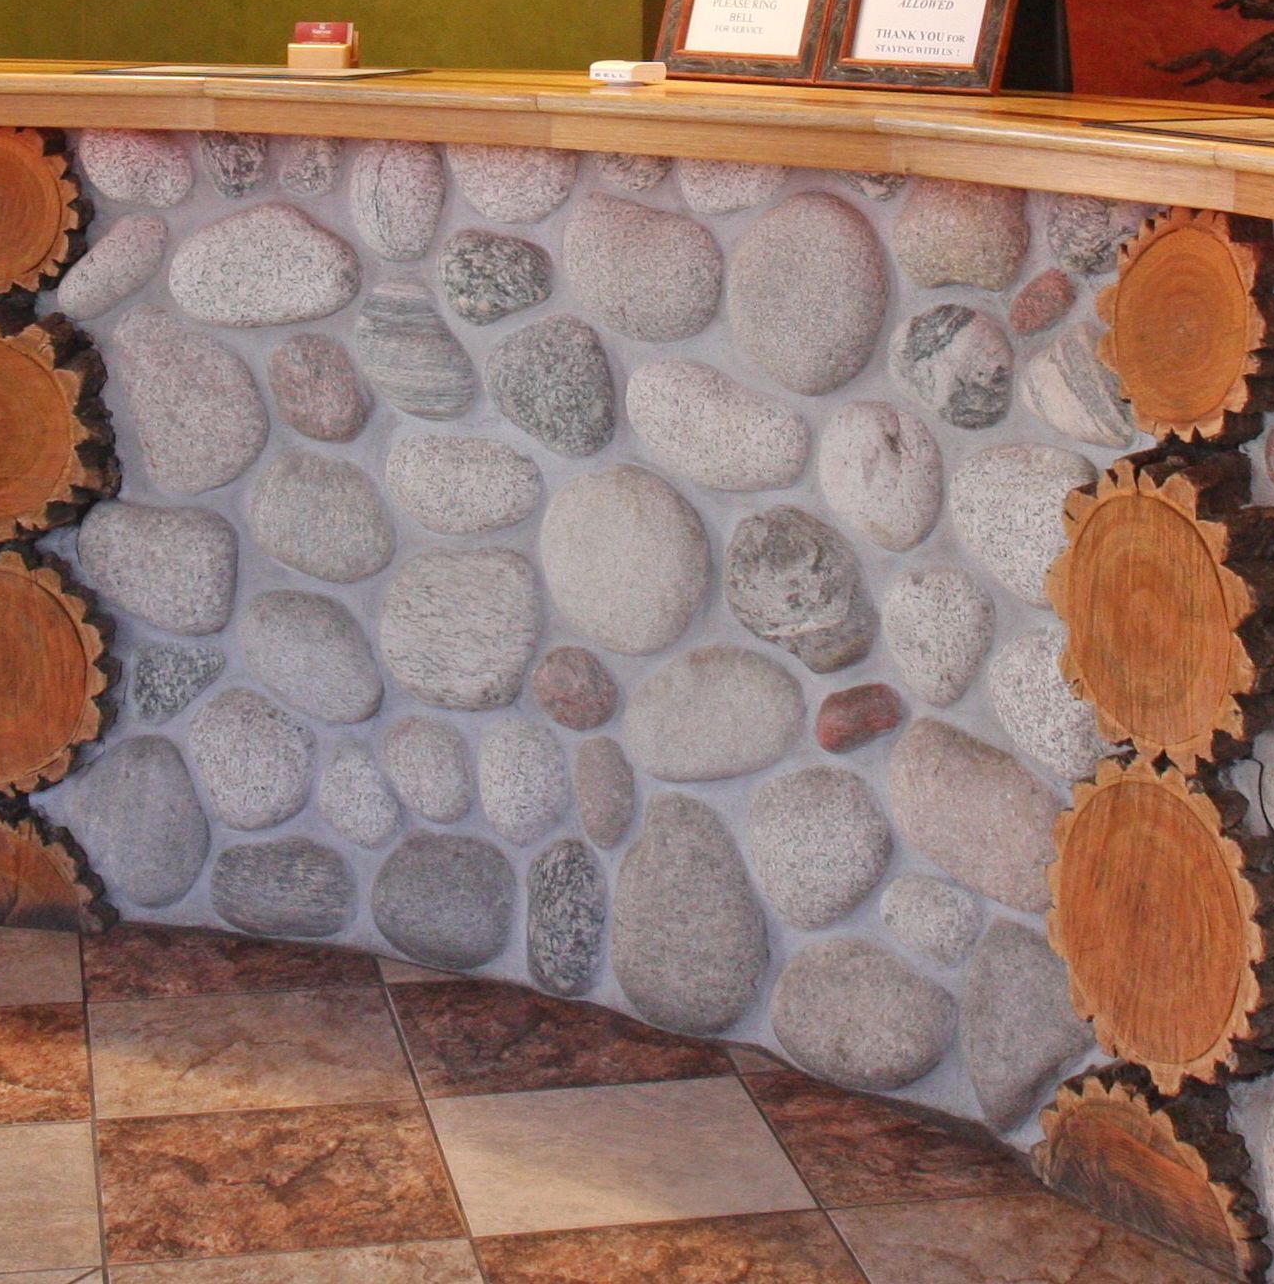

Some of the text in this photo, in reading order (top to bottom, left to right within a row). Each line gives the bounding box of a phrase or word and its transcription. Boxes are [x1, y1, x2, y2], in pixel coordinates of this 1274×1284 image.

[752, 0, 778, 10] RING
[897, 0, 955, 11] ALLOWED
[729, 13, 755, 23] BELL
[714, 25, 730, 33] FOR
[876, 28, 966, 43] THANK YOU FOR
[875, 44, 914, 54] STAYING
[916, 46, 940, 56] WITH
